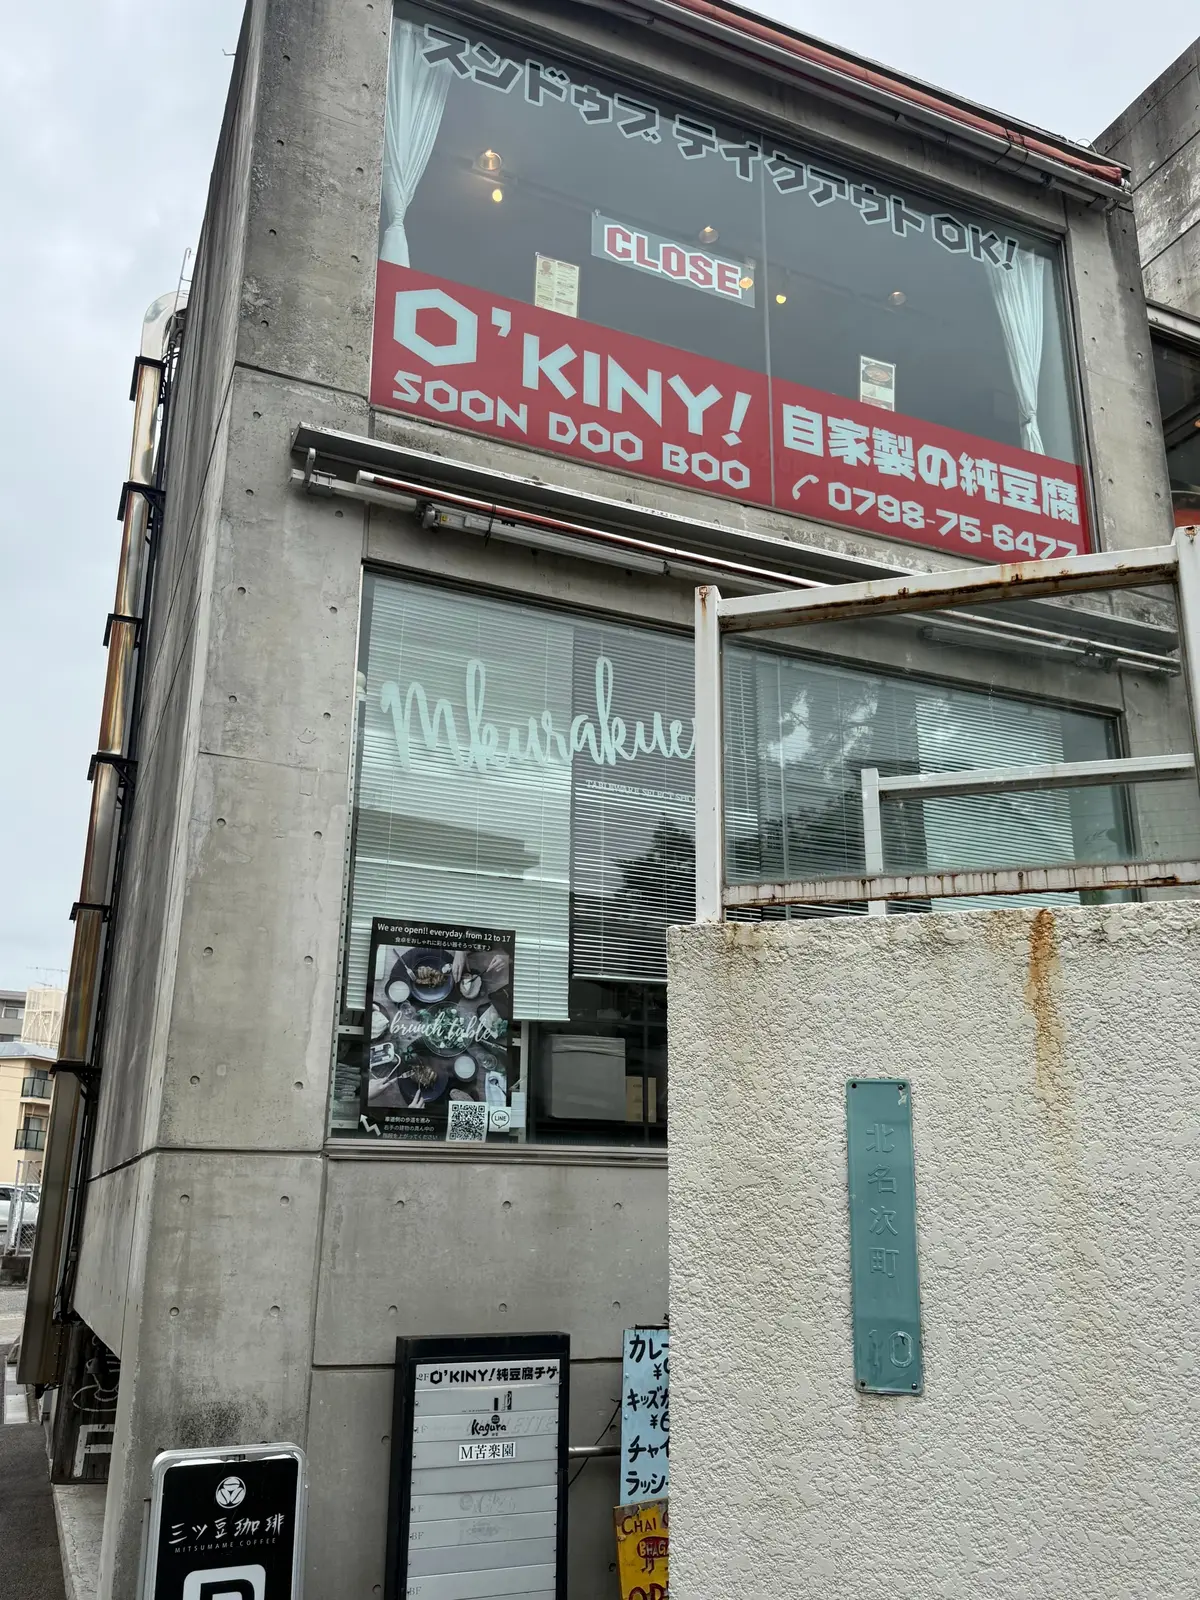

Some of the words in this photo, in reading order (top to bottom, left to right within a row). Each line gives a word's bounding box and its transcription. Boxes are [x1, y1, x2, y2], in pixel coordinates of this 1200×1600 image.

[604, 224, 742, 299] CLOSE
[393, 288, 752, 447] O'KINY!
[392, 370, 528, 435] SOON
[549, 411, 643, 462] DOO
[662, 441, 750, 489] BOO
[782, 403, 1080, 525] 自家製の純豆腐
[585, 780, 639, 796] TABLEWARE
[642, 788, 673, 800] SELECT
[377, 922, 389, 931] We
[390, 925, 403, 933] are
[404, 925, 428, 936] open!!
[429, 928, 463, 940] everyday
[465, 931, 482, 940] from
[484, 933, 492, 941] 12
[494, 934, 501, 942] to
[502, 935, 511, 943] 17
[389, 1011, 444, 1038] brunch
[449, 1015, 495, 1042] table
[866, 1124, 900, 1278] 北名次町
[868, 1329, 914, 1369] 10
[471, 1418, 506, 1437] Kagura
[460, 1443, 515, 1460] M苦楽園
[168, 1513, 285, 1544] 三ツ豆珈琲
[622, 1515, 657, 1536] CHAI
[174, 1541, 235, 1554] MITSUMAME
[240, 1538, 277, 1548] COFFEE
